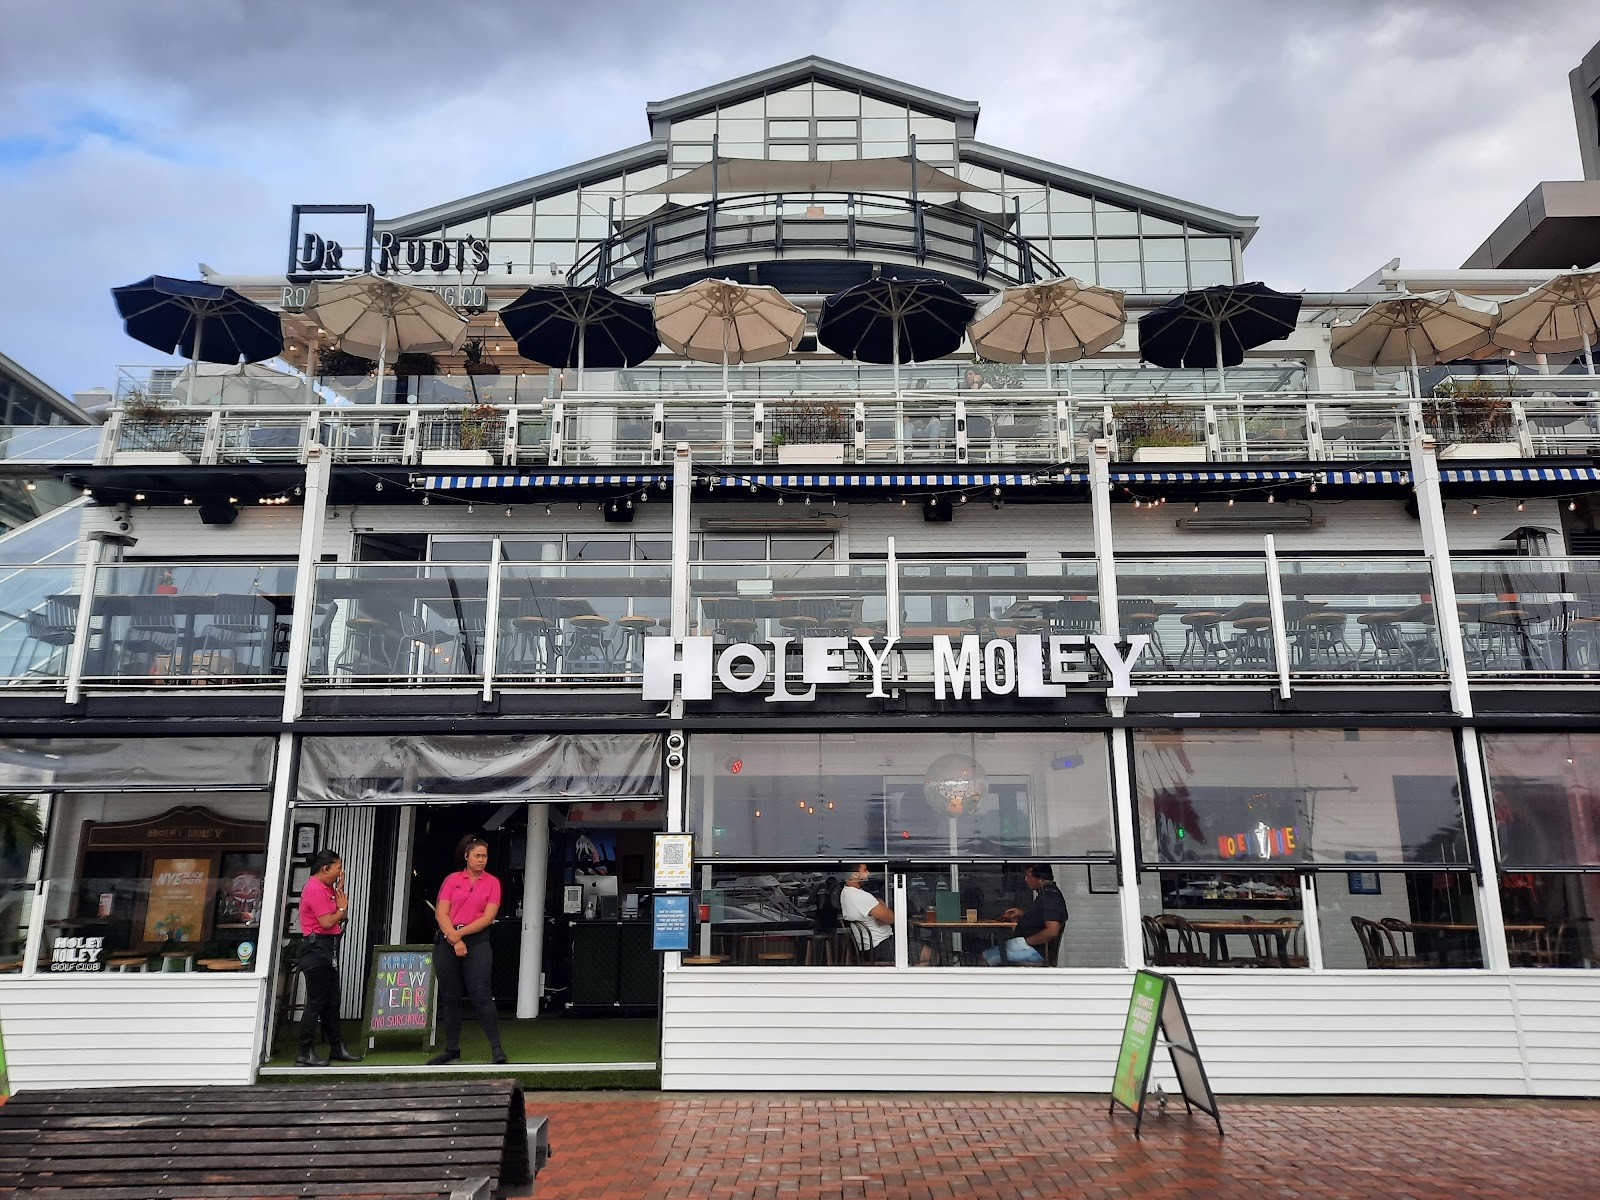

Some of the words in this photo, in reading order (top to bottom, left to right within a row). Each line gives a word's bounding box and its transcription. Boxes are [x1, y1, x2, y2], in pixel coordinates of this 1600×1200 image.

[461, 287, 484, 307] CO
[642, 636, 900, 702] HOLEY
[933, 634, 1150, 700] MOLEY
[156, 872, 184, 886] NYE
[54, 936, 105, 949] HOLEY
[52, 948, 103, 963] MOLEY
[382, 955, 426, 969] HAPPY
[51, 963, 76, 971] GOLF
[76, 963, 101, 971] CLUB
[386, 969, 426, 988] NEW
[380, 987, 428, 1009] YEAR
